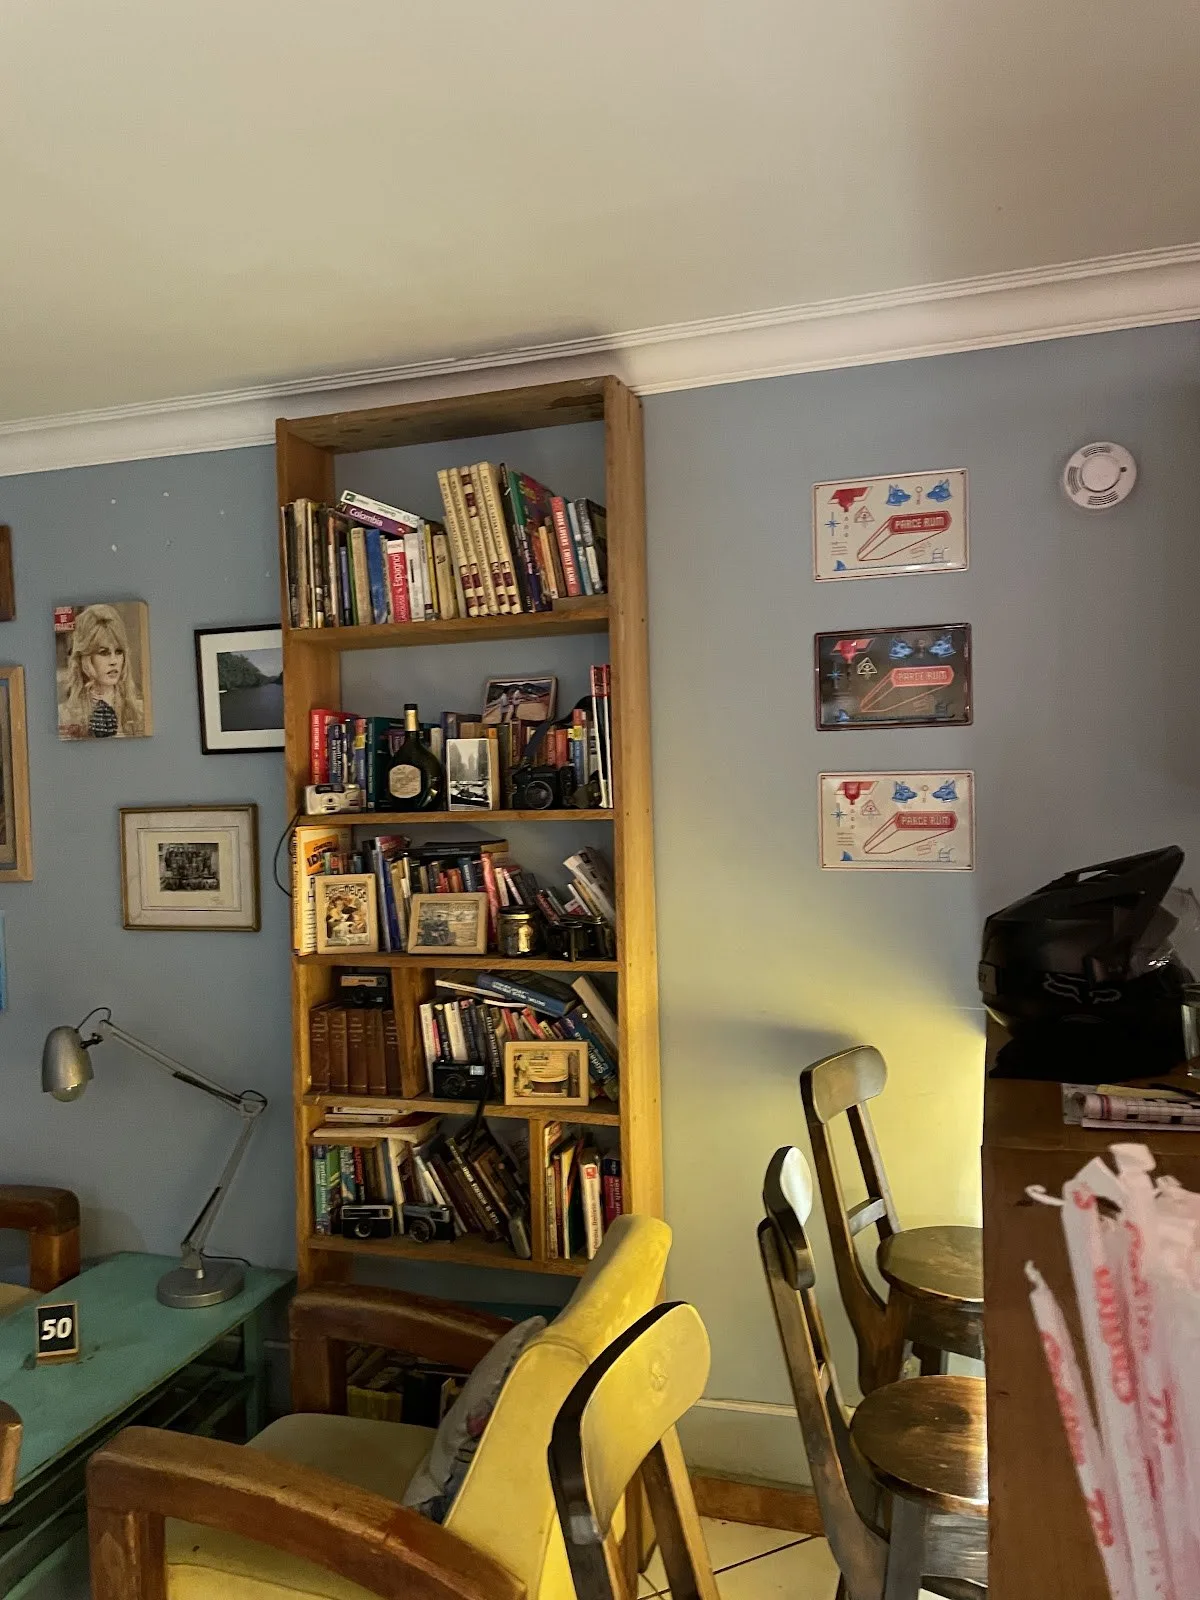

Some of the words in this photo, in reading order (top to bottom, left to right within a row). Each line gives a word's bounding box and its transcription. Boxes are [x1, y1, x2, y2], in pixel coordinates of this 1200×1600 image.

[349, 508, 384, 526] Colombia
[392, 553, 404, 587] Espagnol
[41, 1317, 72, 1340] 50
